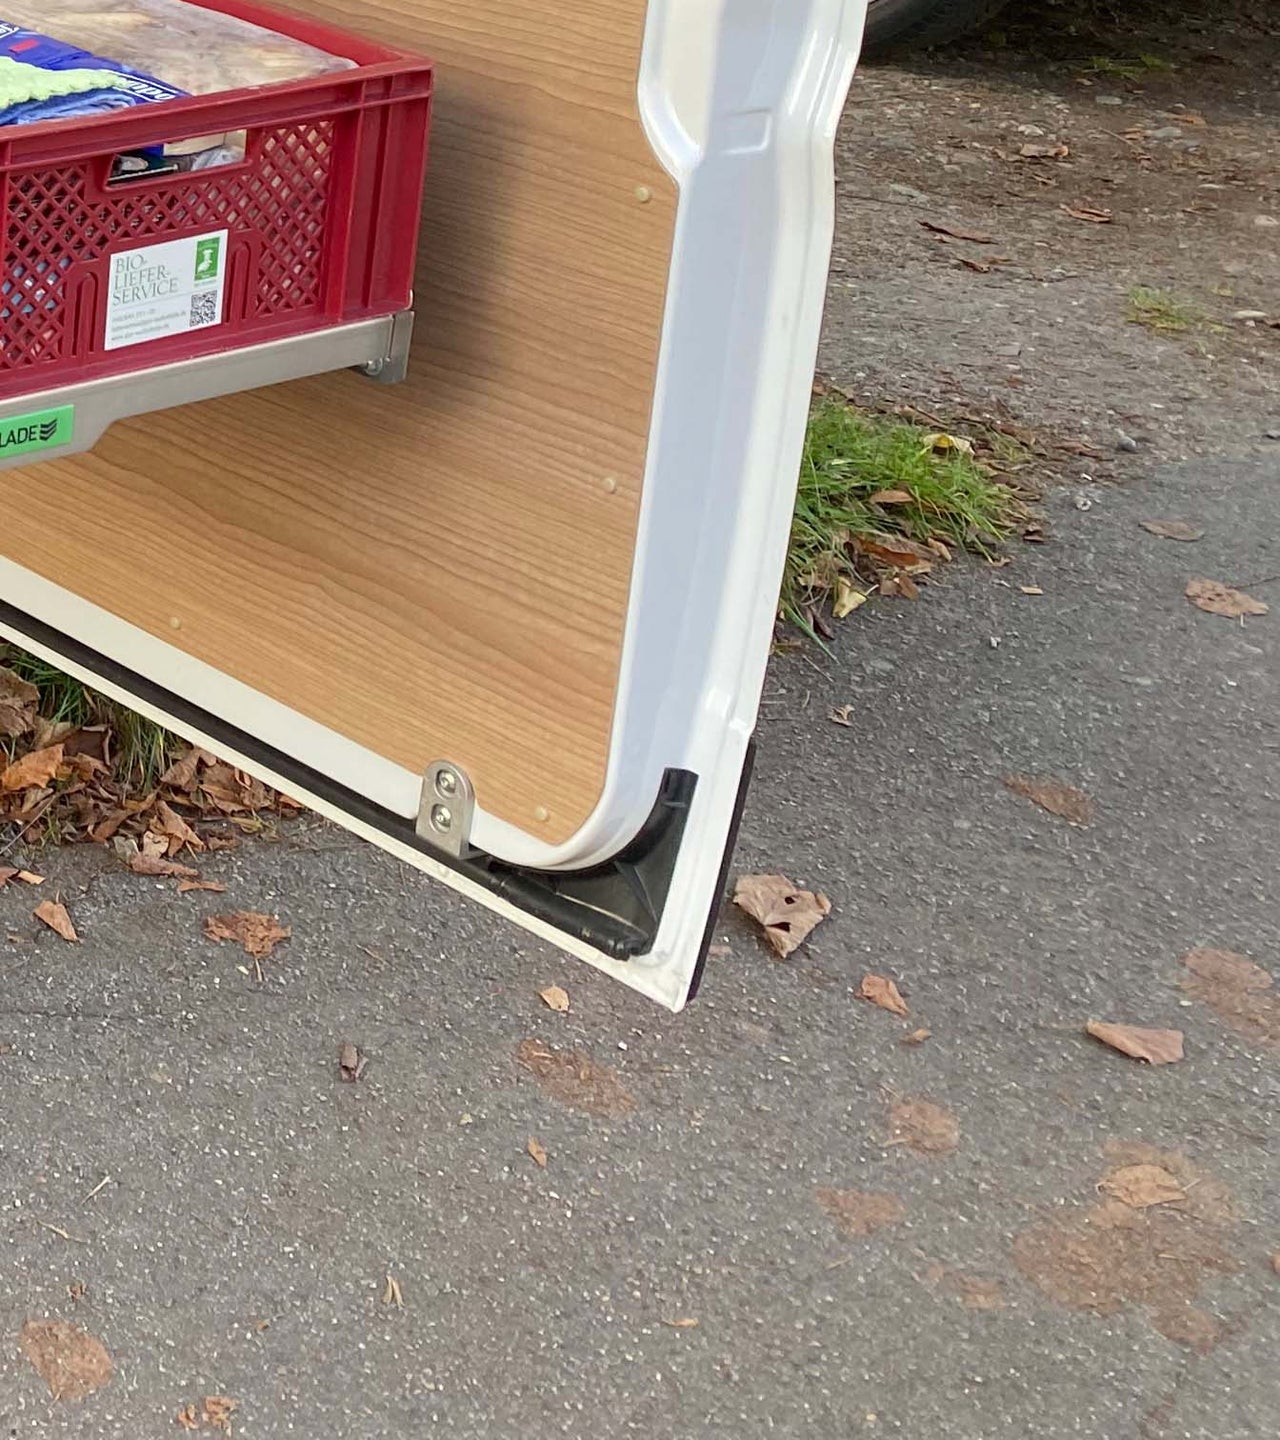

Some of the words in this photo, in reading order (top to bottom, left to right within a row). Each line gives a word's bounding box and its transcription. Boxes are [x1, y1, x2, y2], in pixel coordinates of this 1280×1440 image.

[116, 254, 147, 274] BIO-
[114, 265, 171, 291] LIEFER-
[111, 278, 178, 306] SERVICE
